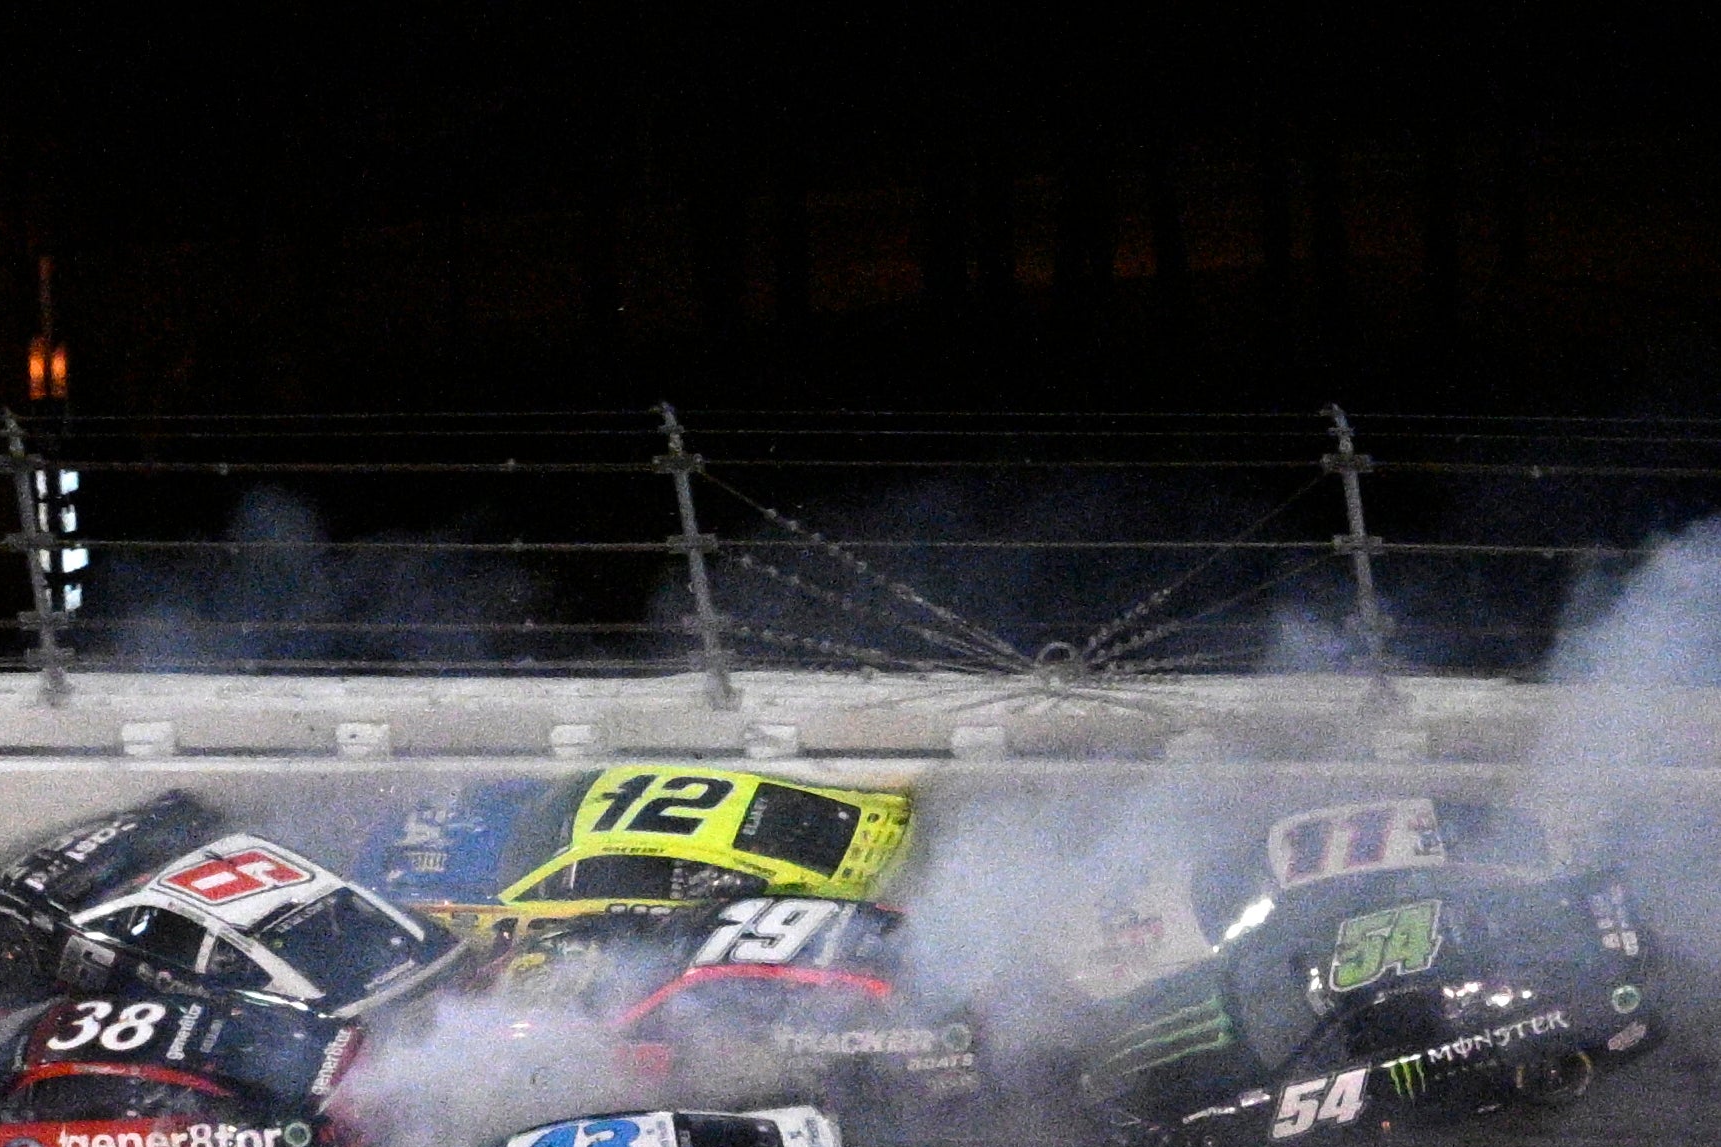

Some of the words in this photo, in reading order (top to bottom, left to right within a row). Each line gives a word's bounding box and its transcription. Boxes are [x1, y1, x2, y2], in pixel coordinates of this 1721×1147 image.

[592, 774, 735, 836] 12
[694, 899, 834, 966] 19
[1332, 901, 1442, 991] 54
[47, 1000, 166, 1052] 38
[1272, 1069, 1369, 1139] 54
